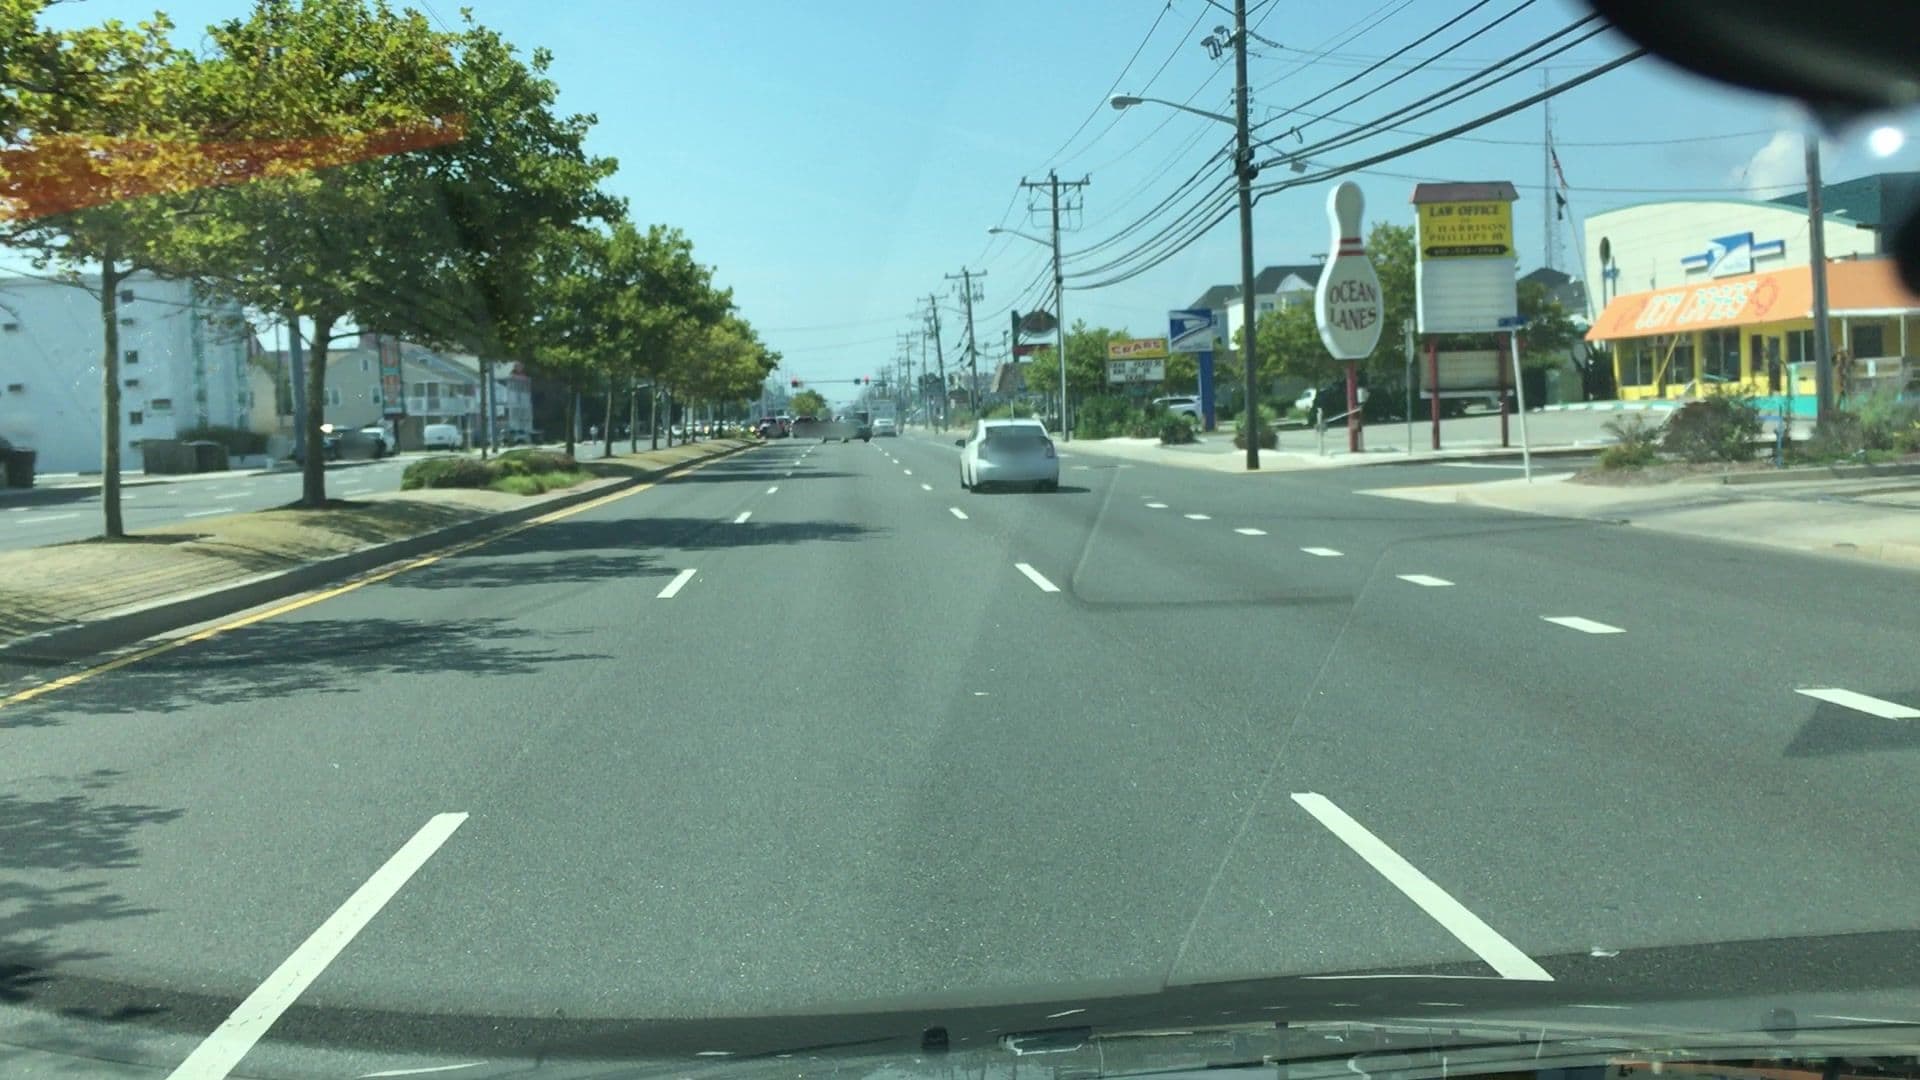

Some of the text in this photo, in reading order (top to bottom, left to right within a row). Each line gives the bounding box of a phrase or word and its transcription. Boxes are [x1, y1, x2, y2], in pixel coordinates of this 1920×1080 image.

[1429, 204, 1499, 217] LAW OFFICE
[1438, 223, 1506, 233] HARRISON
[1329, 280, 1377, 304] OCEAN
[1330, 307, 1377, 331] LANES
